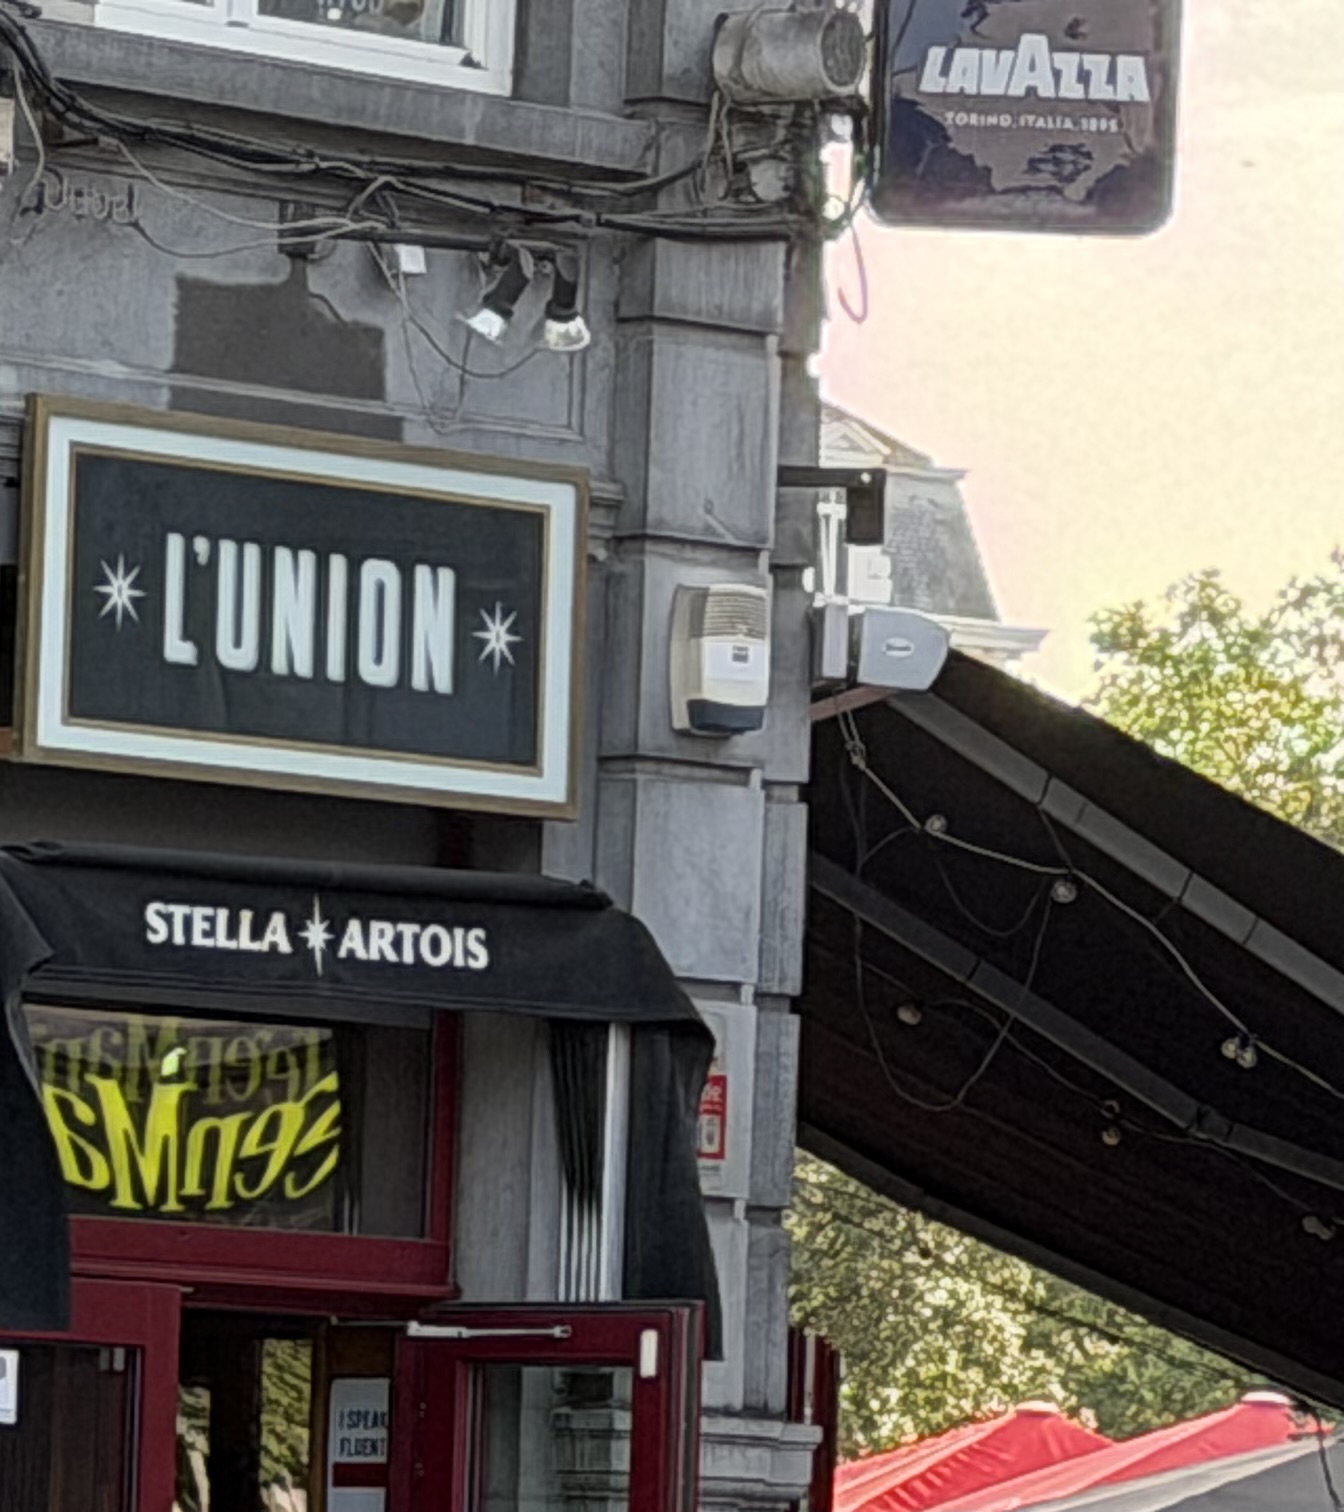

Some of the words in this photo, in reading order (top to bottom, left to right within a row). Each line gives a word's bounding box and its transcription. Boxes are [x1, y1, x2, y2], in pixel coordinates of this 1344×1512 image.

[918, 33, 1151, 101] LAVAZZA
[163, 532, 457, 695] L'UNION
[144, 901, 293, 954] STELLA
[337, 918, 489, 970] ARTOIS
